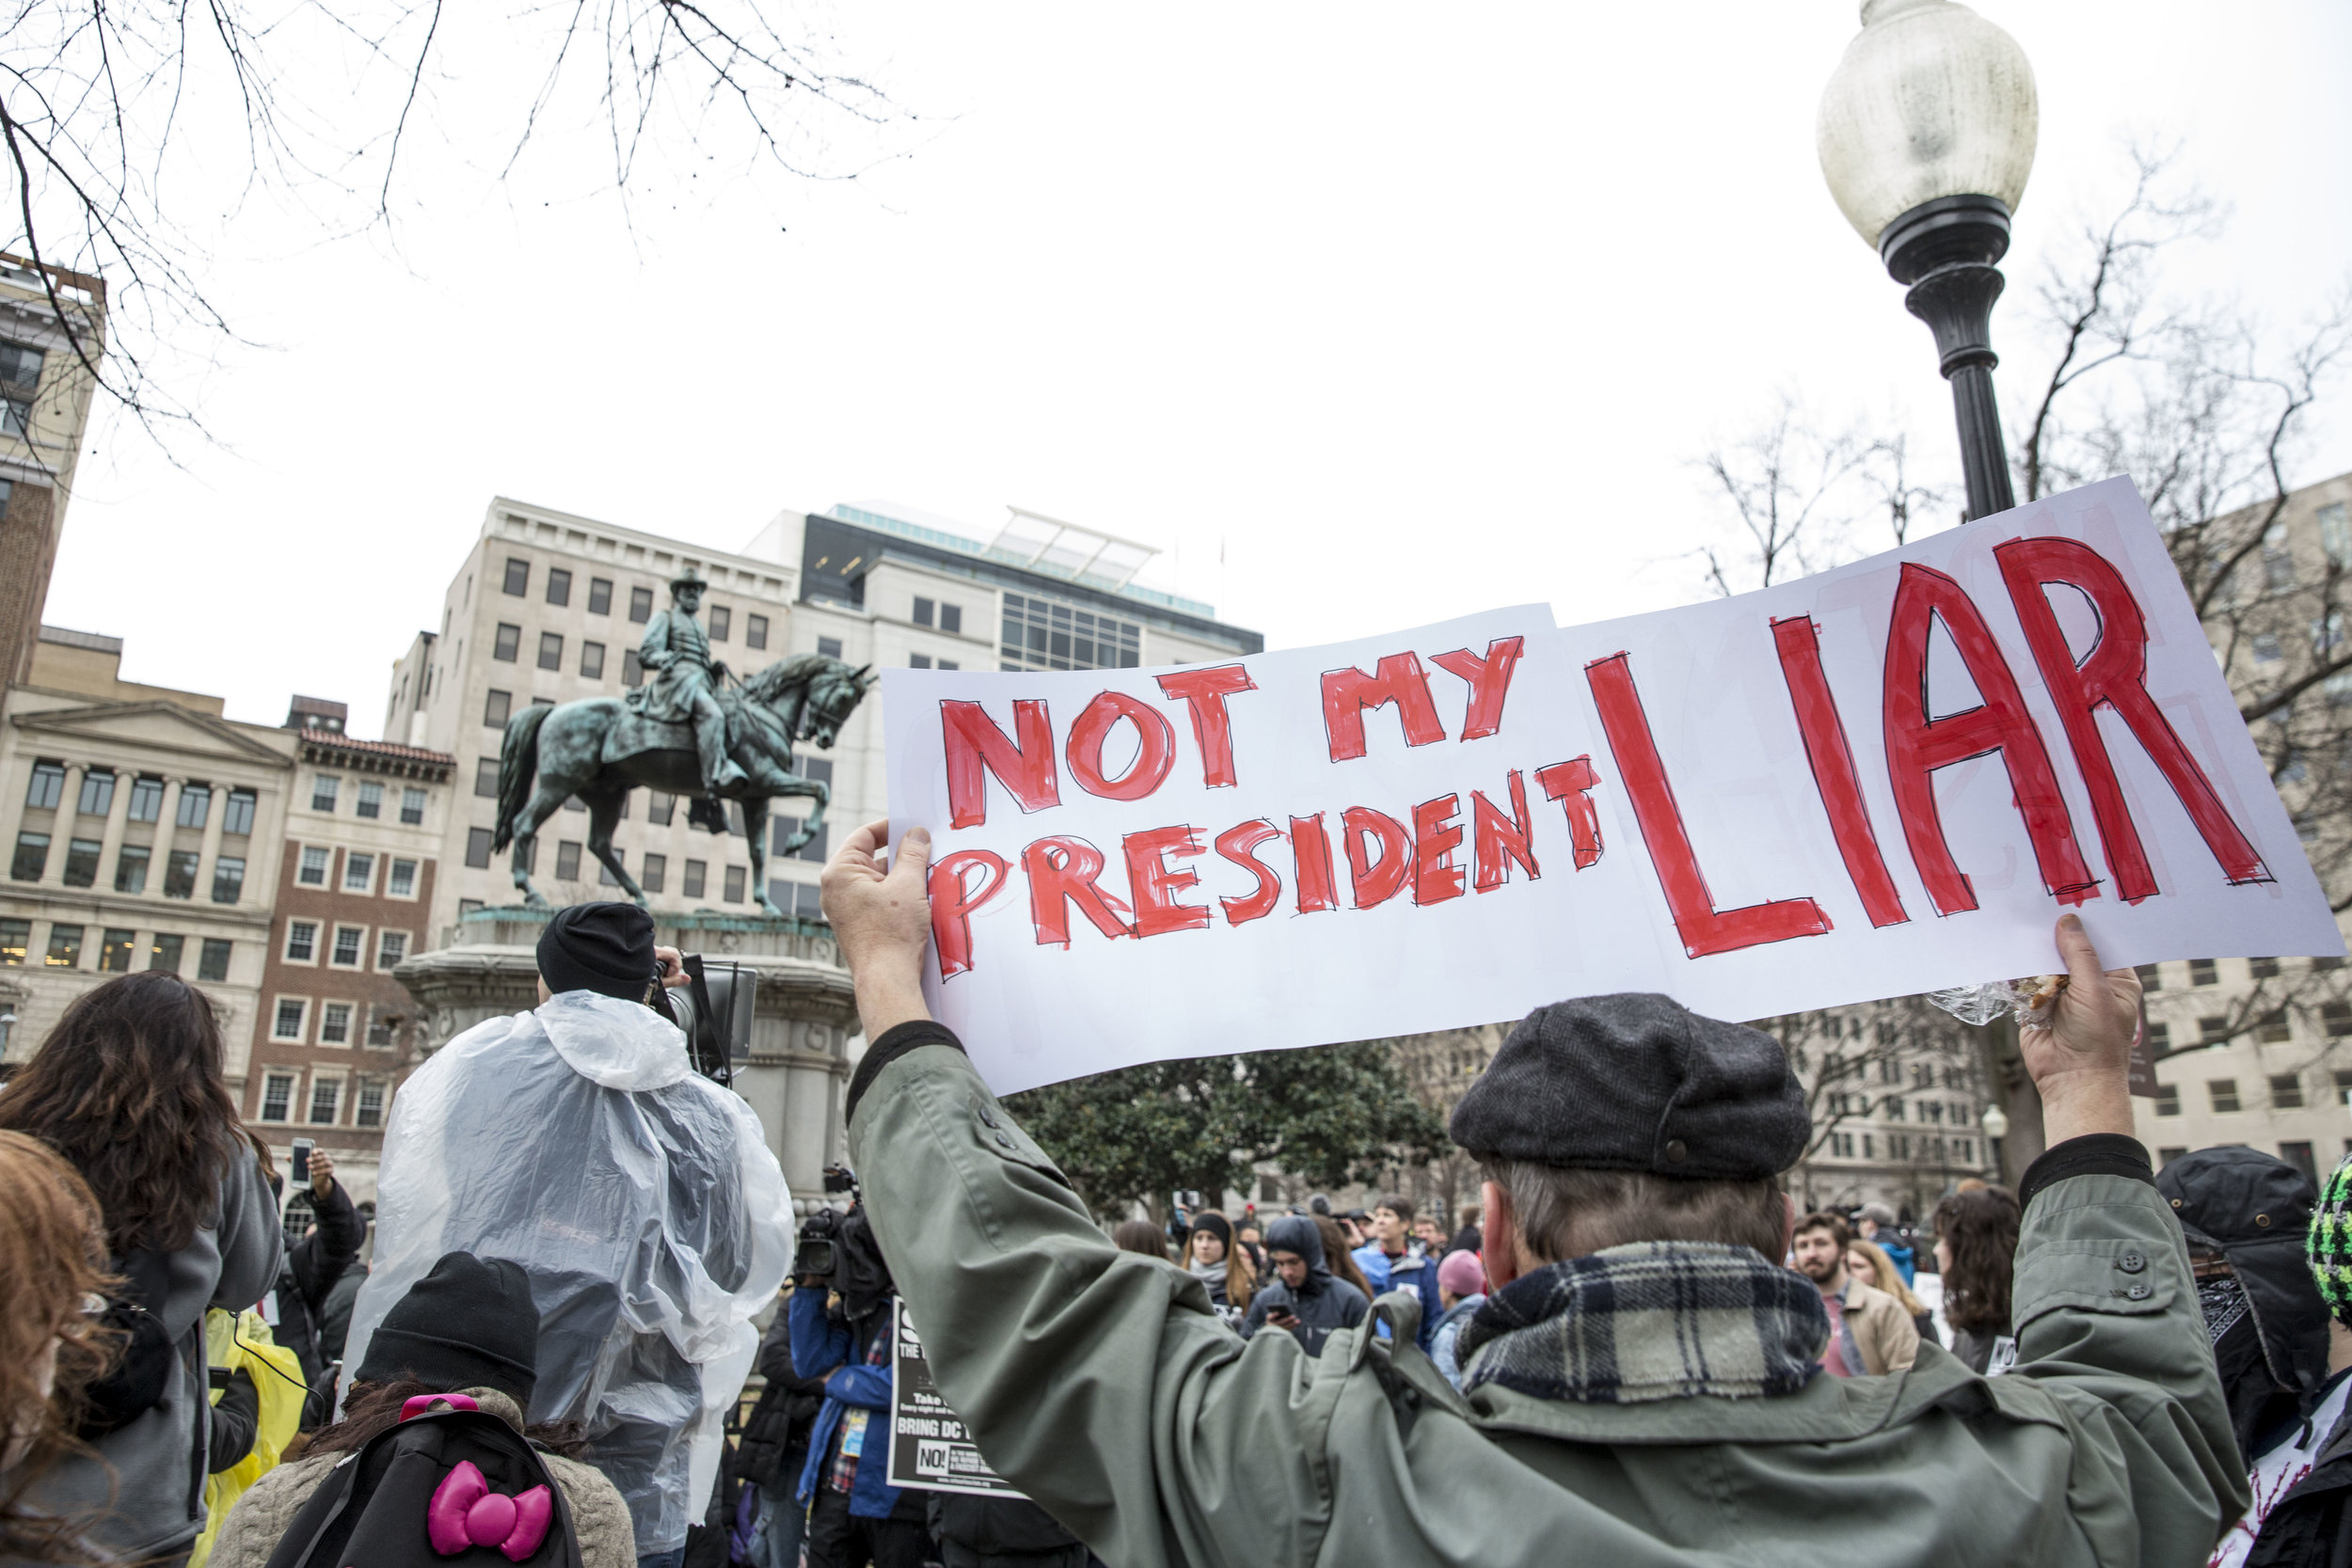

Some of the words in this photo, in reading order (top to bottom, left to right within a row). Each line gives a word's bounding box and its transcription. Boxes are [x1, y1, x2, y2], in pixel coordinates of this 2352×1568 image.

[940, 661, 1256, 832] NOT
[1321, 635, 1525, 764] MY
[1584, 535, 2277, 960] LIAR
[927, 753, 1601, 984] PRESIDENT
[899, 1342, 920, 1359] THE
[914, 1392, 942, 1406] Take
[898, 1417, 939, 1437] BRING
[942, 1420, 961, 1439] DC
[920, 1448, 946, 1468] NO!
